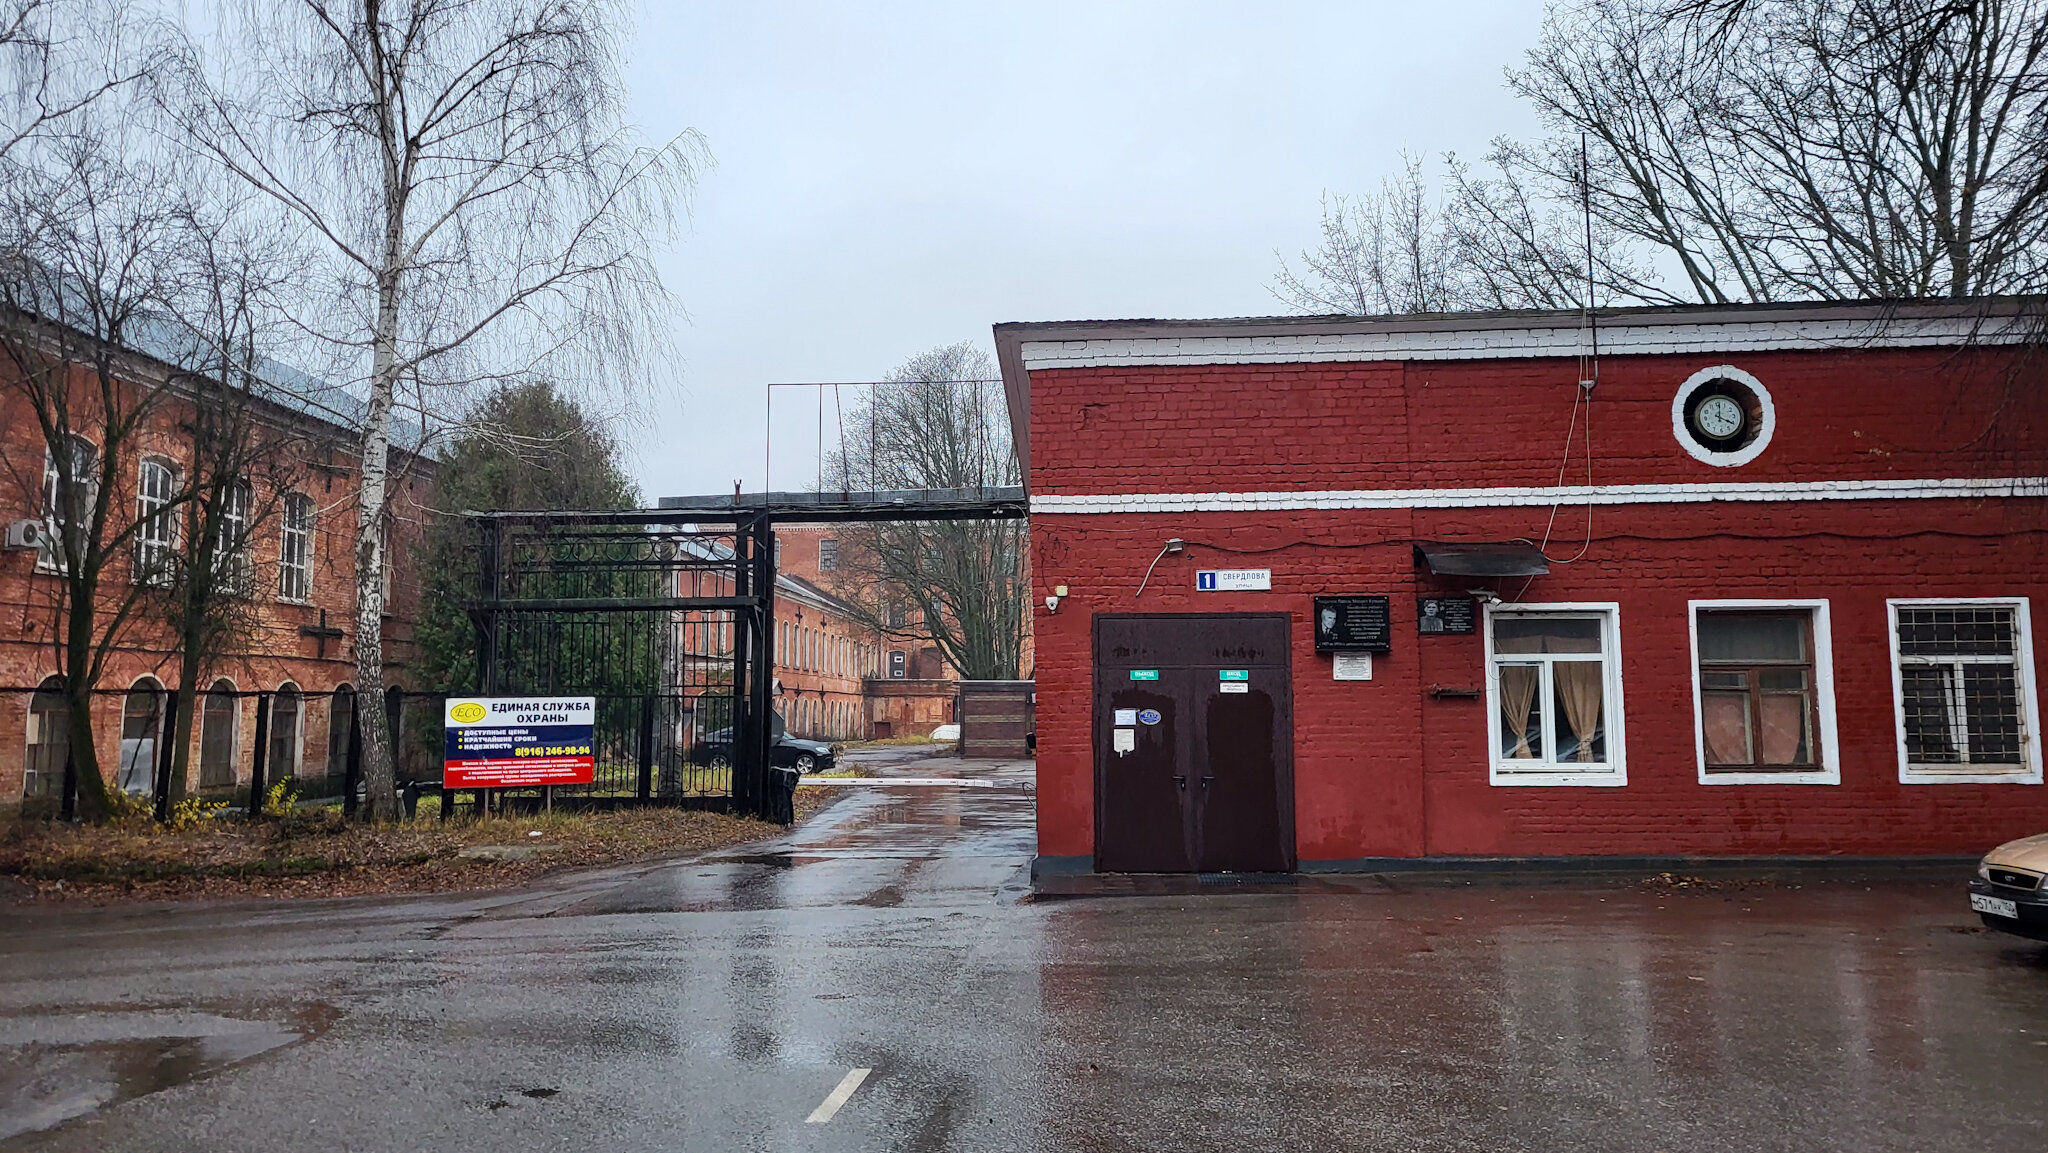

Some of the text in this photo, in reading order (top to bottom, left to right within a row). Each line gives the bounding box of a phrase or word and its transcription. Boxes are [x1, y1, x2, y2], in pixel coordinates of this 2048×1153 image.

[1204, 572, 1266, 589] 1 СВЕРДЛОВА
[455, 707, 482, 718] ECO
[492, 702, 590, 713] ЕДИНАЯ СЛУЖБА
[516, 714, 568, 723] ОХРАНЫ
[515, 746, 590, 757] 8(916) 246-98-94
